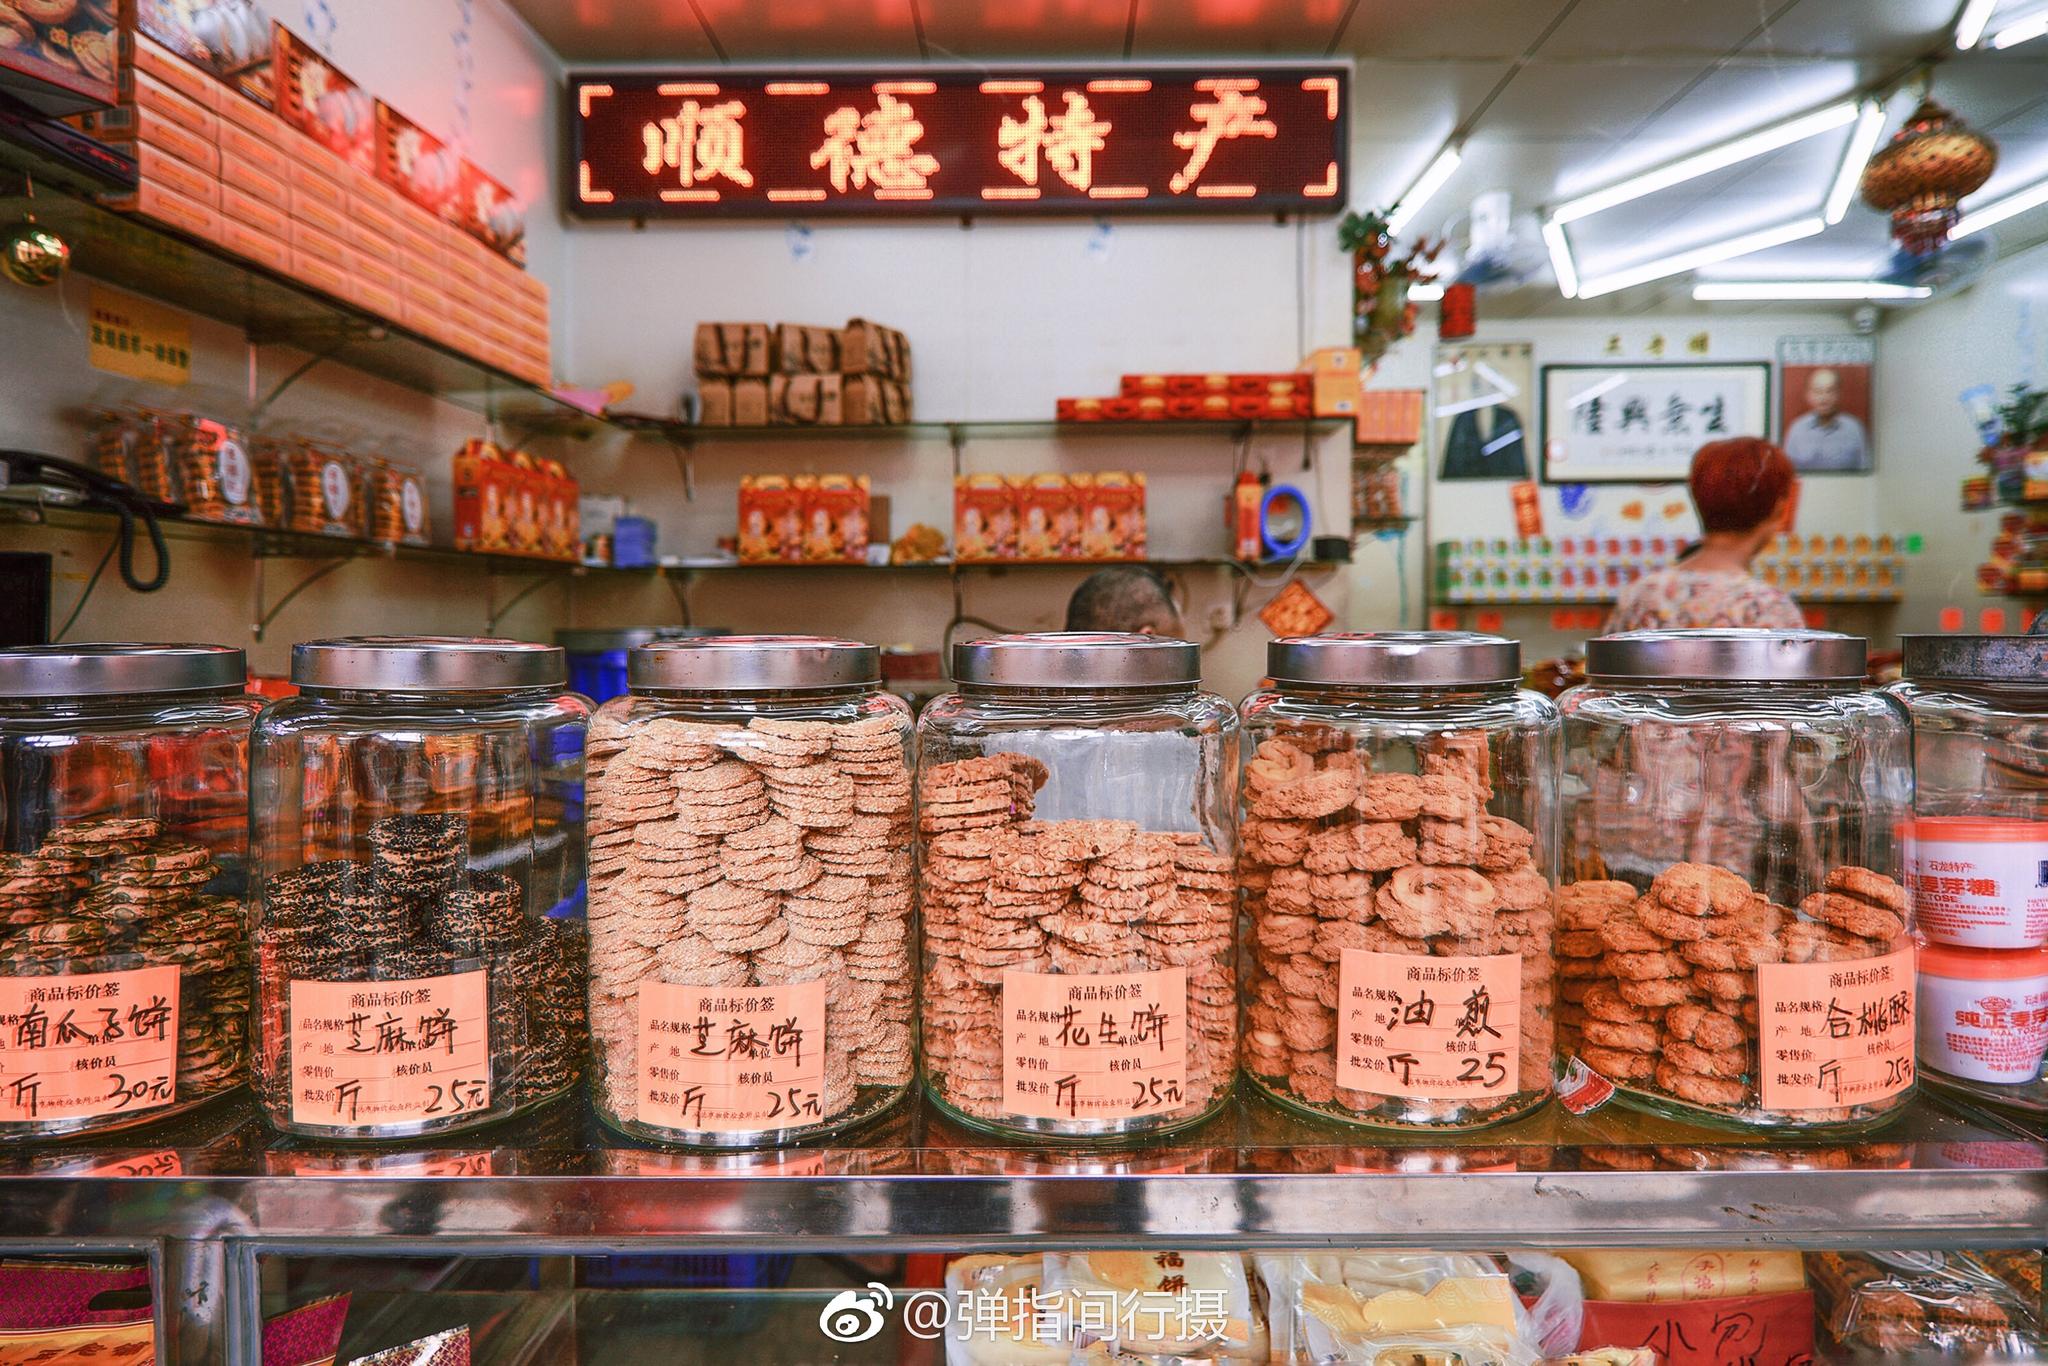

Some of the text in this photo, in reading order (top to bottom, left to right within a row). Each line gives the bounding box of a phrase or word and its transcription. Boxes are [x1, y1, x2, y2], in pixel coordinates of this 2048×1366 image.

[643, 90, 1277, 193] 顺德特产
[1407, 966, 1481, 982] 商品标价签
[1829, 966, 1891, 988] 商品标价签
[29, 981, 121, 1003] 商品标价签
[351, 988, 432, 1007] 商品标价签
[1068, 983, 1143, 1001] 商品标价签
[699, 997, 776, 1013] 商品标价签
[1774, 1001, 1822, 1013] 品名规格
[17, 995, 172, 1049] 南瓜子饼
[303, 1008, 458, 1054] 品名规格 芝麻饼
[1016, 1003, 1169, 1051] 品名规格 花生饼
[650, 1016, 803, 1067] 品名规格 芝麻饼
[1350, 1032, 1478, 1053] 零售价 核价员
[1776, 1040, 1892, 1061] 零售价 核价员
[75, 1055, 117, 1071] 核价员
[303, 1061, 433, 1078] 零售价 核价员
[1016, 1056, 1142, 1072] 零售价 核价员
[1350, 1051, 1506, 1088] 批发价 斤 25
[649, 1066, 774, 1085] 零售价 核价员
[1777, 1073, 1814, 1086] 批发价
[1818, 1059, 1841, 1103] 斤
[10, 1073, 173, 1117] 斤 30元
[304, 1079, 486, 1121] 批发价 斤 25元
[1016, 1074, 1184, 1117] 批发价 斤 25元
[649, 1086, 822, 1128] 批发价 斤 25元
